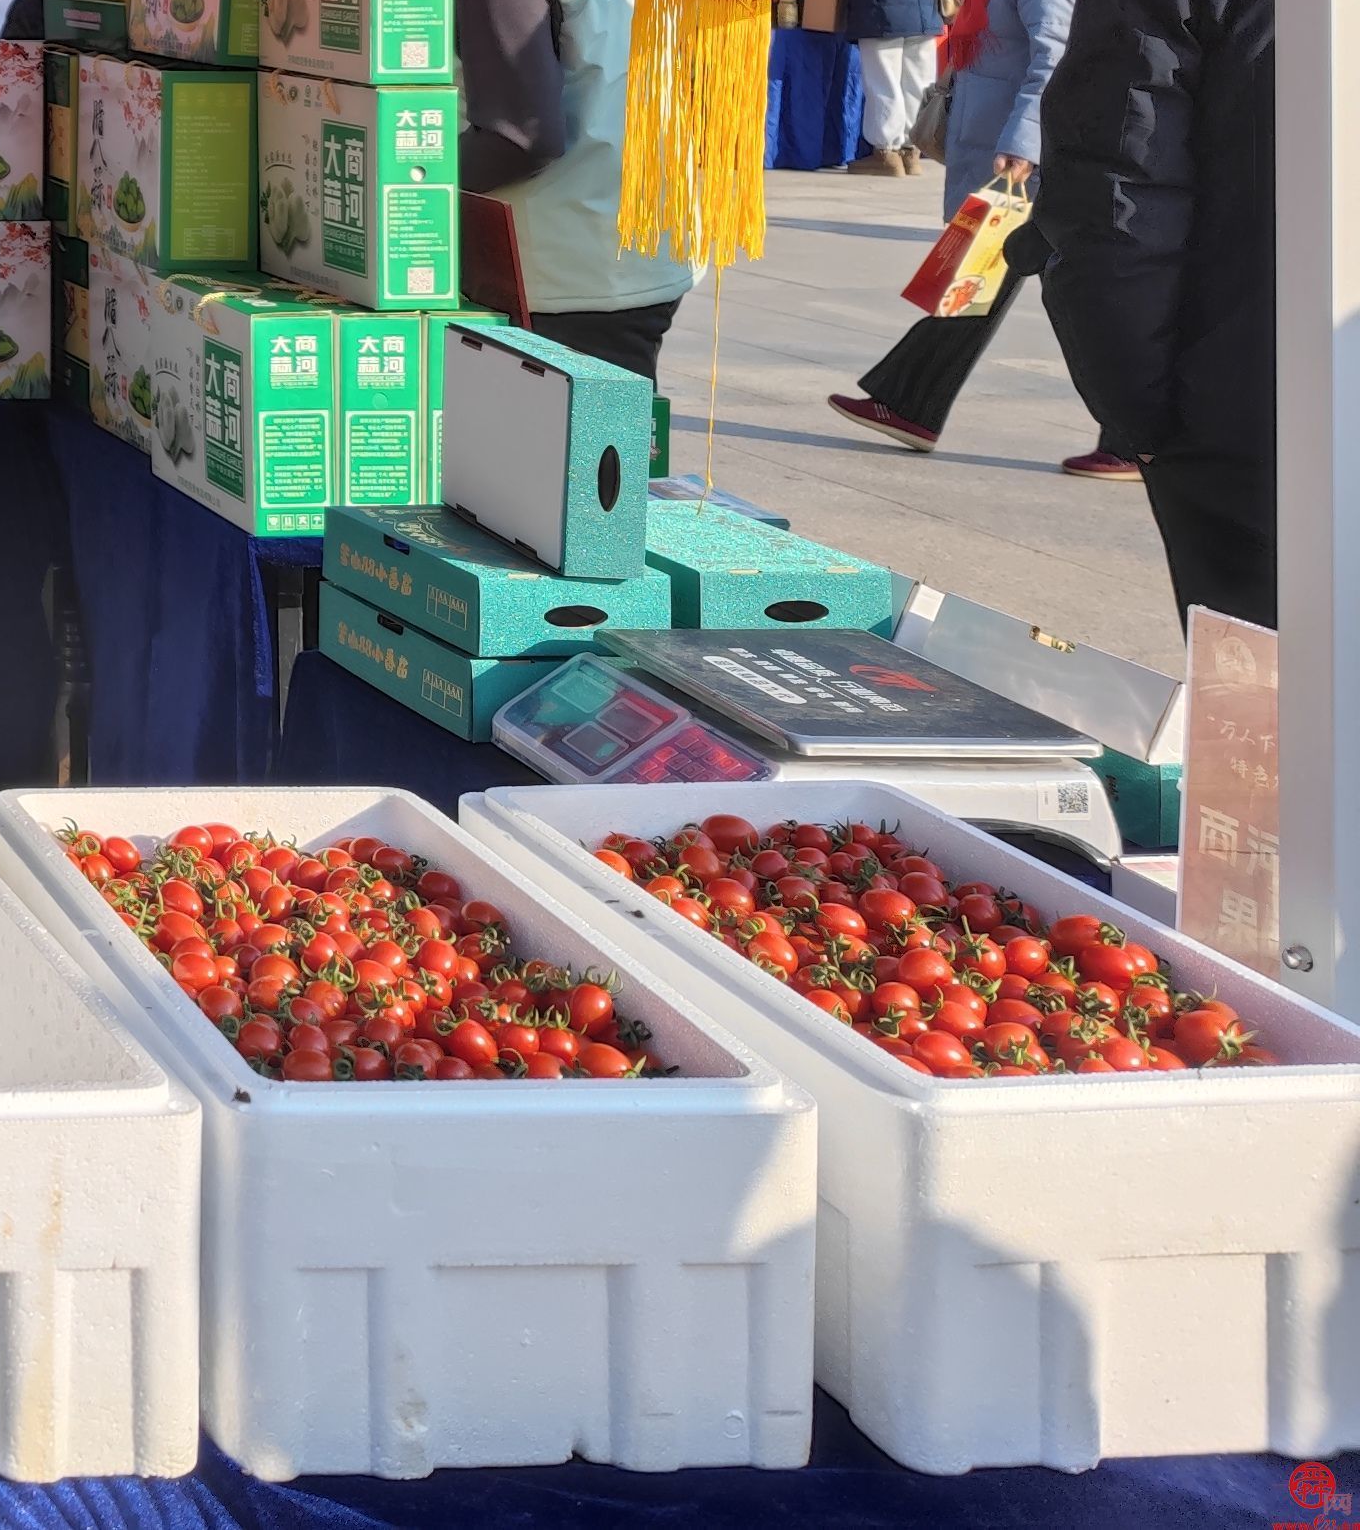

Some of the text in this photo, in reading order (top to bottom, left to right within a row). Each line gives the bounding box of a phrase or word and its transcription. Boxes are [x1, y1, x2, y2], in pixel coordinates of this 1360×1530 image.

[830, 680, 909, 712] 行业典范
[1230, 755, 1278, 789] 特色
